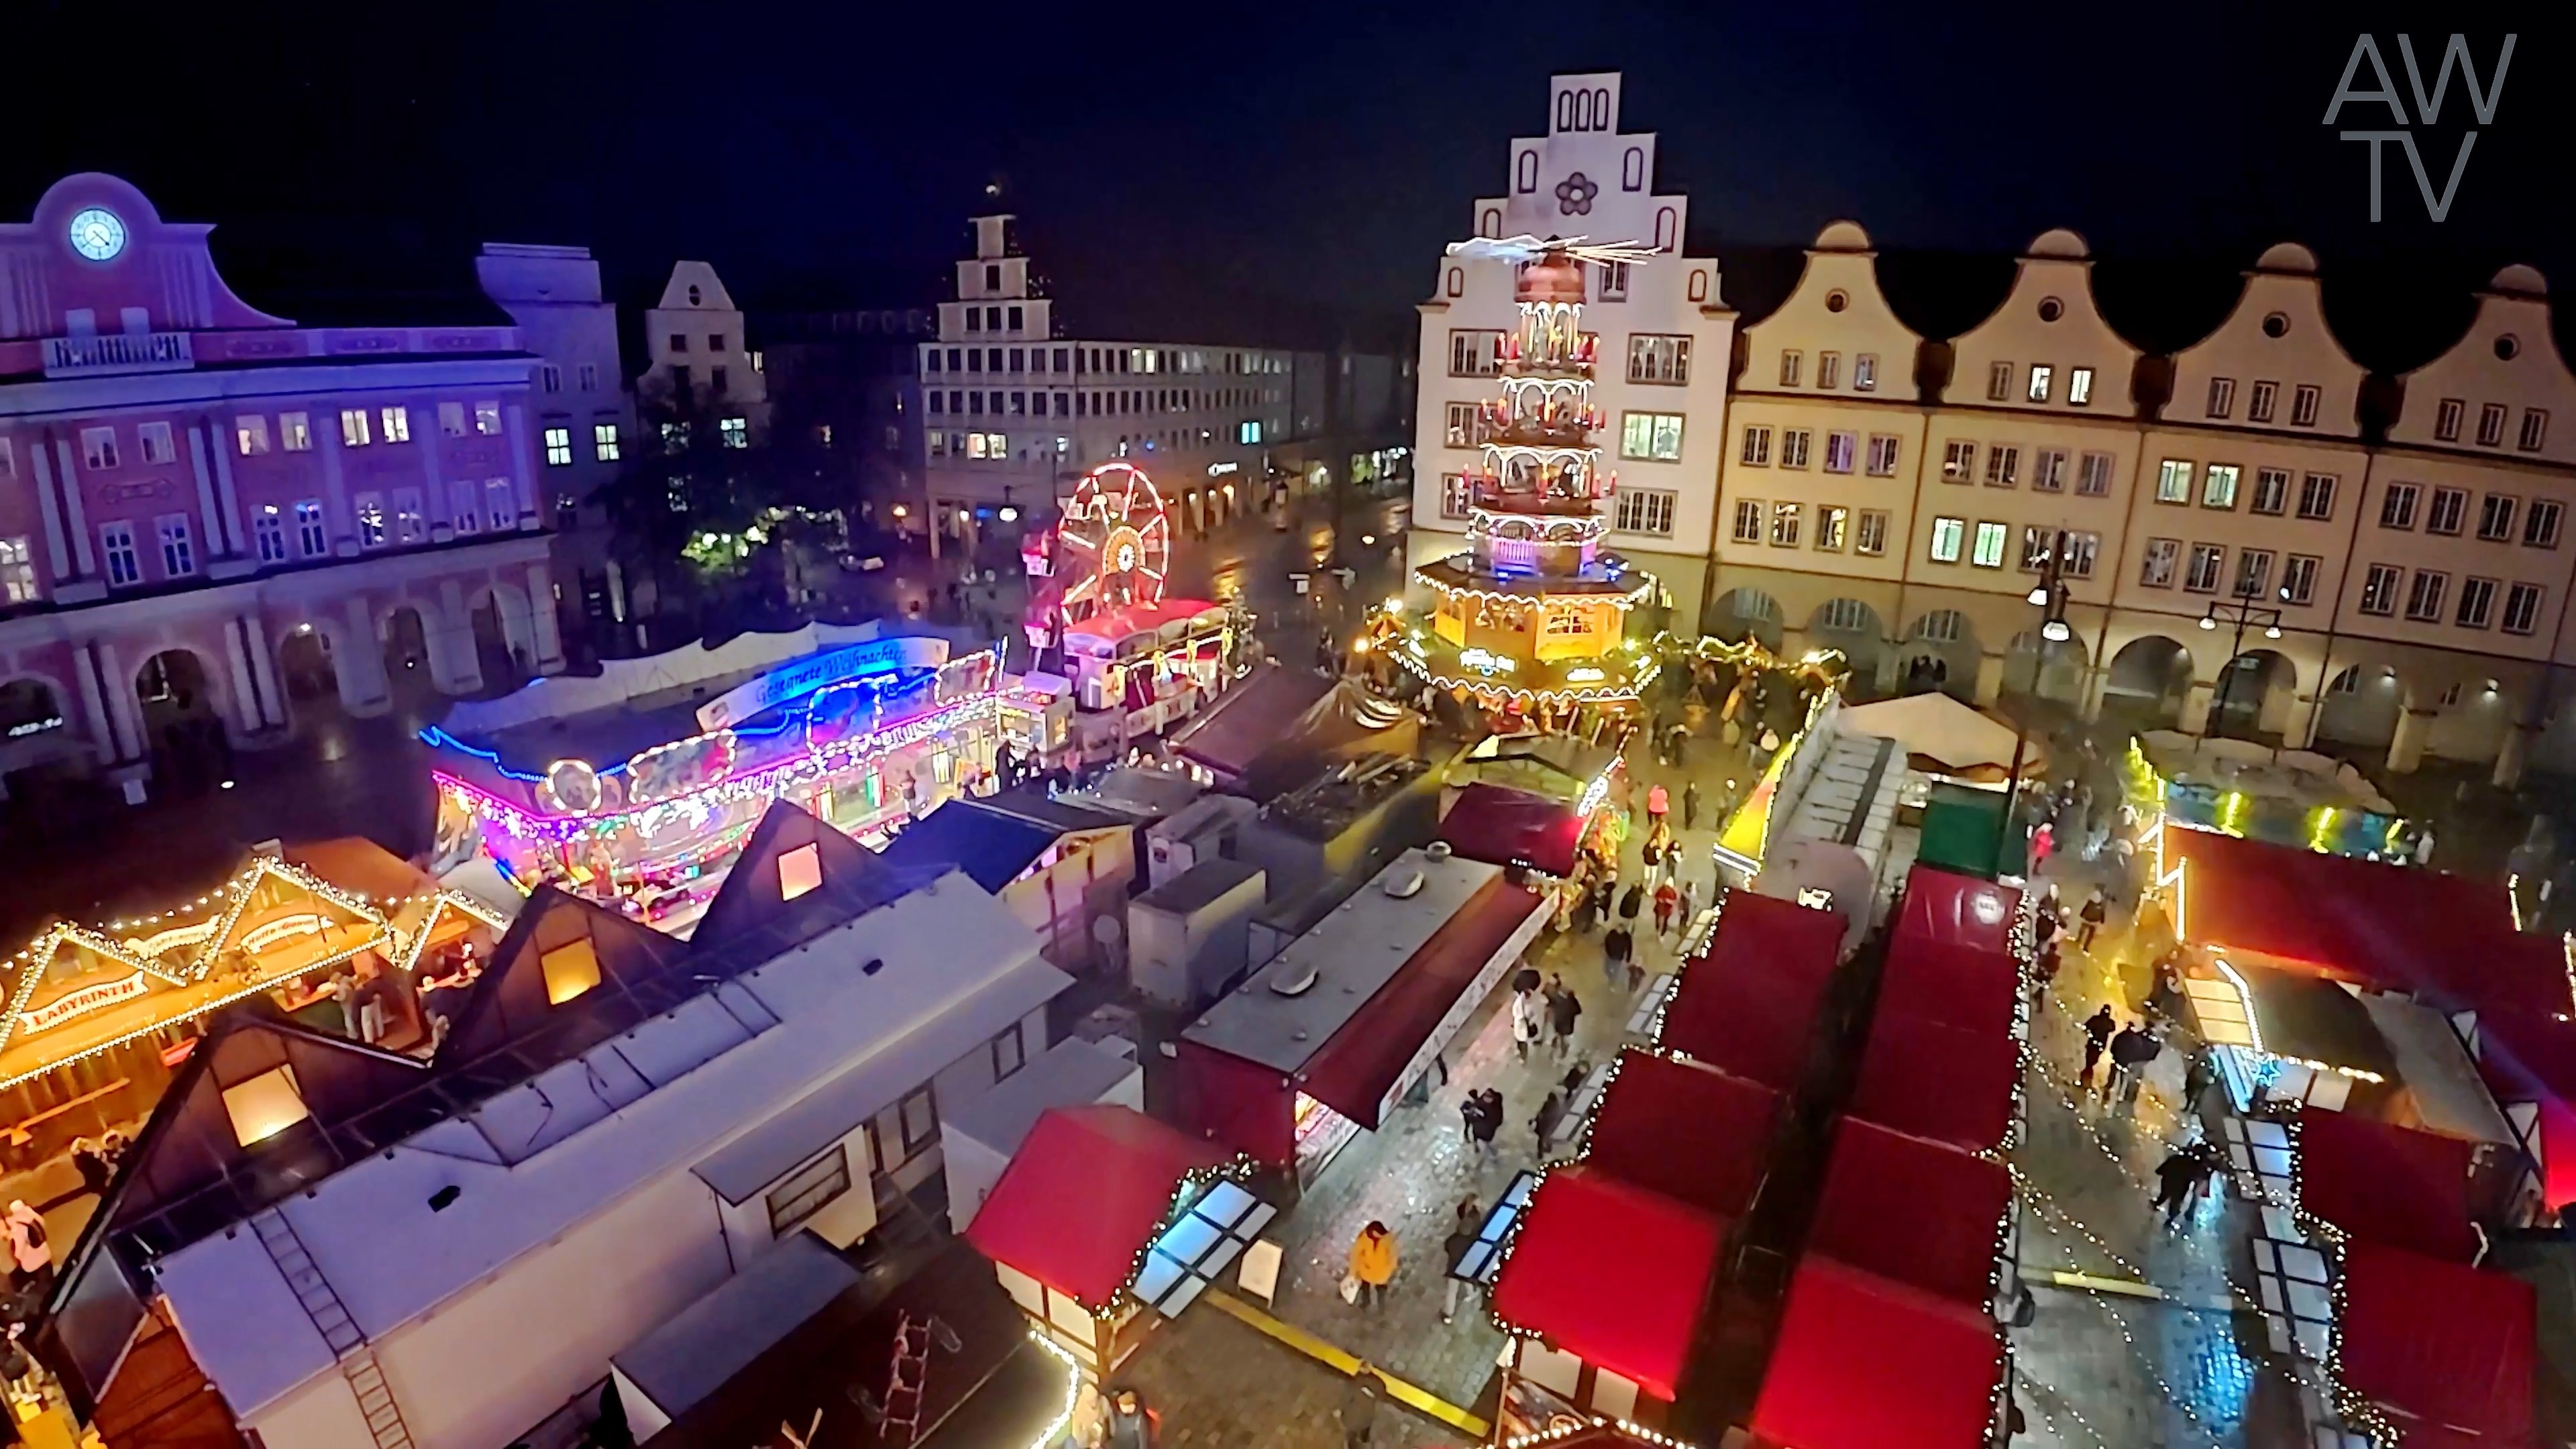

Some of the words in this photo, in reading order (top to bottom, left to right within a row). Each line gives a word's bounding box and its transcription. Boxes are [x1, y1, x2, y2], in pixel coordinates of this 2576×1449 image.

[755, 666, 820, 704] Gesegnete
[825, 644, 907, 676] Weihnachten
[33, 981, 134, 1026] LABYRINTH
